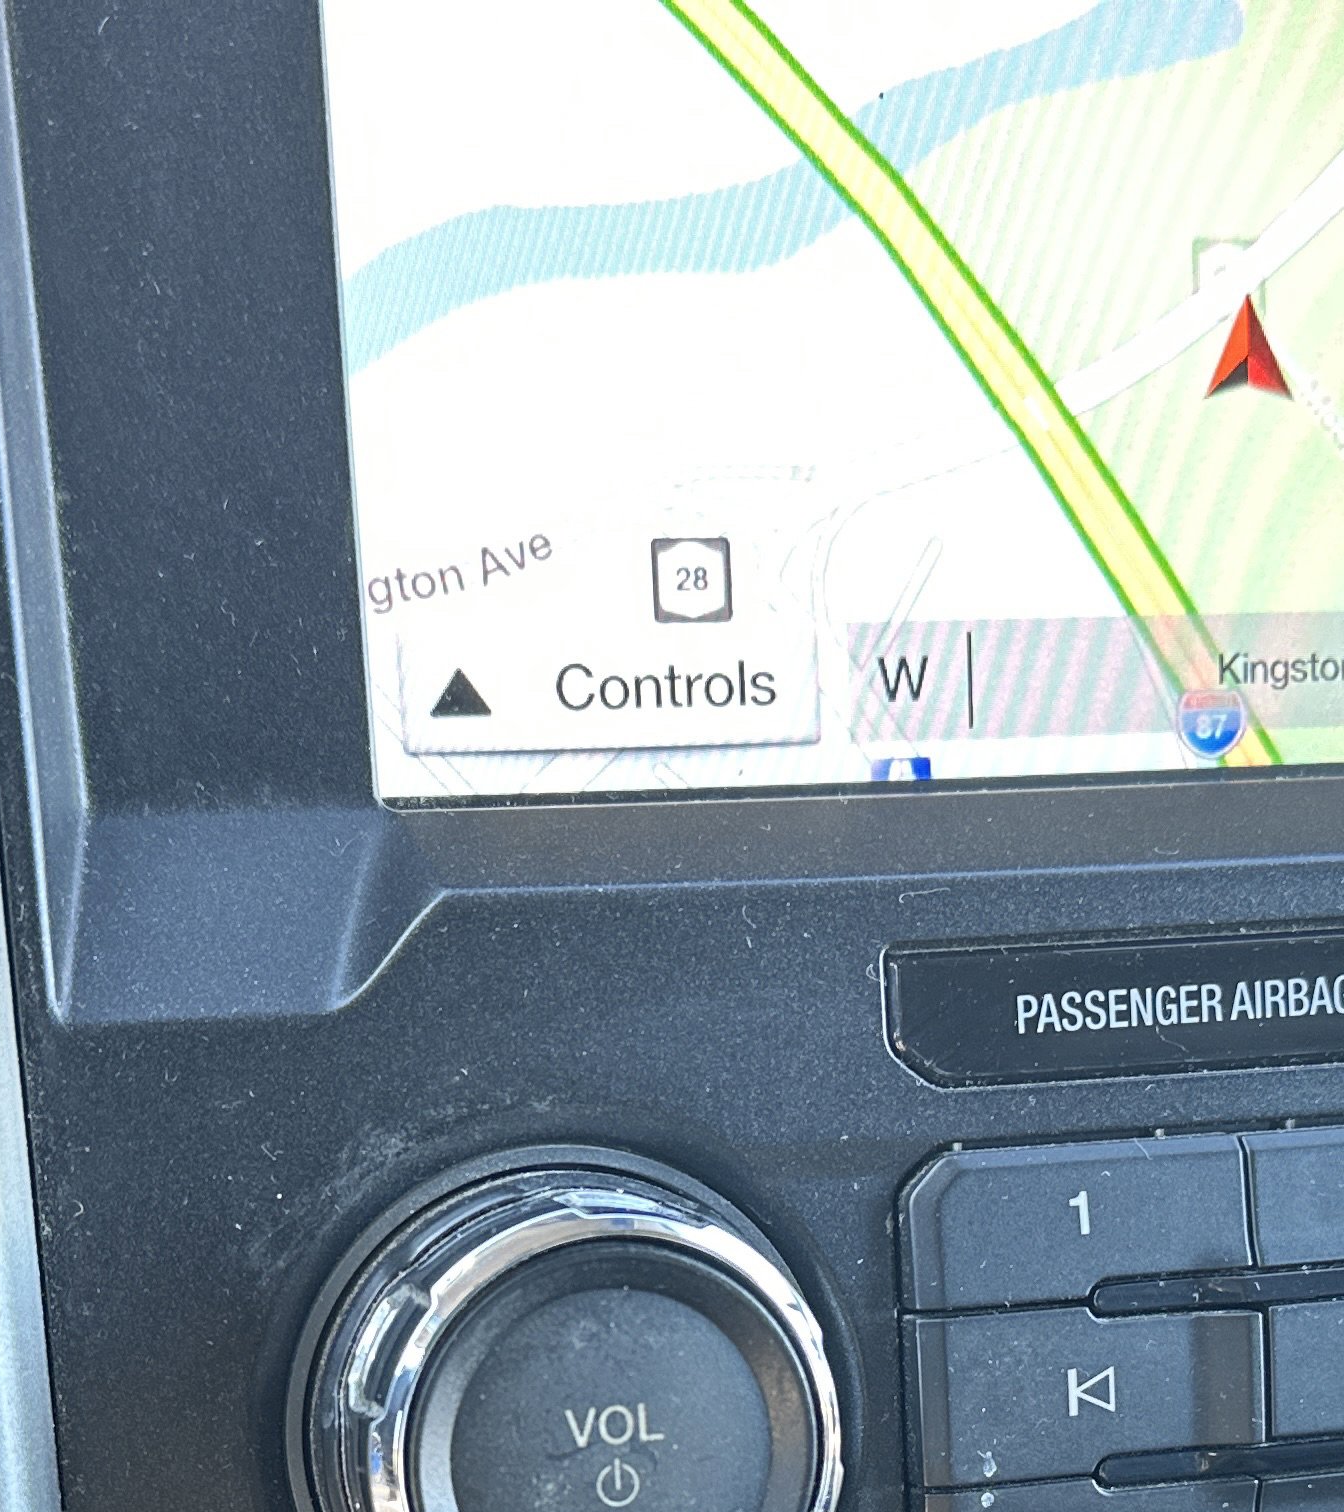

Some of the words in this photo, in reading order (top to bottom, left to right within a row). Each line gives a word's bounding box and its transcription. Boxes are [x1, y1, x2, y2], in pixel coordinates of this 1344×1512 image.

[367, 563, 466, 614] gton
[481, 533, 554, 587] Ave
[675, 567, 710, 592] 28
[555, 659, 778, 711] Controls
[877, 655, 930, 703] W
[1195, 713, 1228, 740] 87
[1015, 982, 1224, 1036] PASSENGER
[1067, 1190, 1093, 1236] 1
[563, 1402, 666, 1449] VOL
